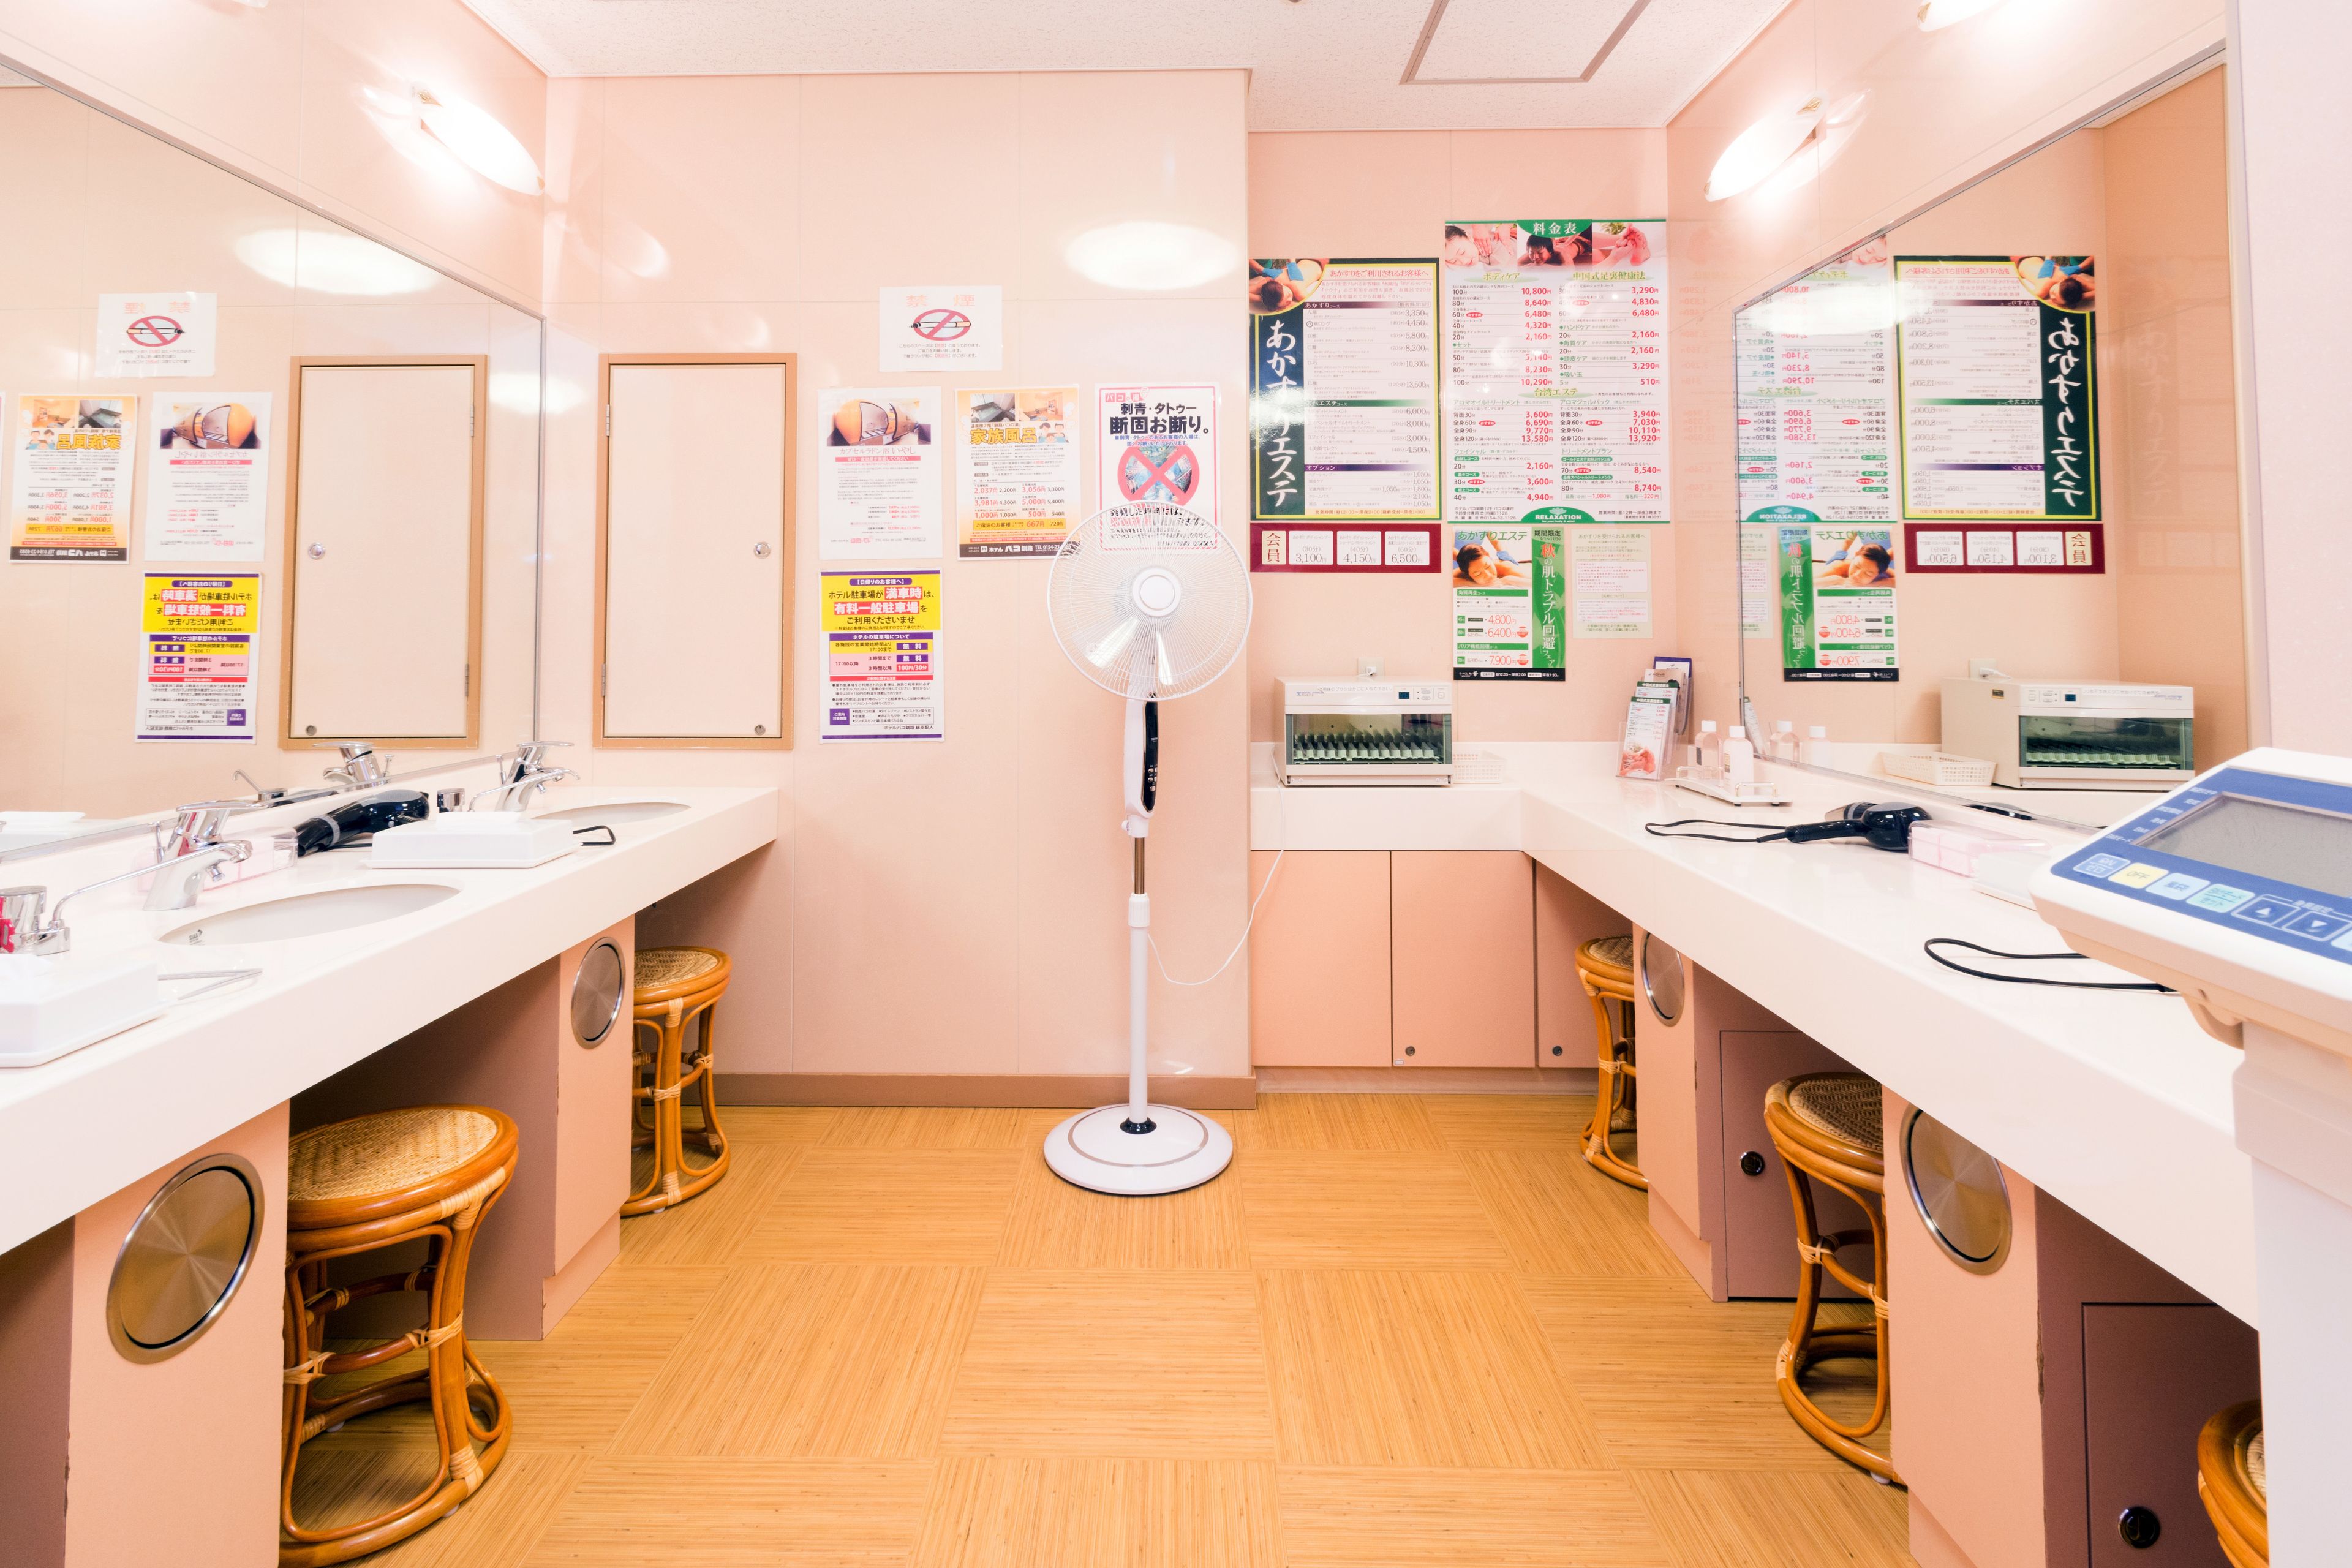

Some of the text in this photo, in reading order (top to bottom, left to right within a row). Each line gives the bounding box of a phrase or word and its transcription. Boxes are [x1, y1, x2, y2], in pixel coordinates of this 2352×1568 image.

[1532, 222, 1577, 235] 料金表
[1573, 271, 1646, 280] 中国式足裏健康法
[1121, 403, 1197, 415] 刺青・タトゥー
[1110, 416, 1209, 434] 断固お断り。
[970, 428, 1037, 445] 家族風呂
[1457, 530, 1528, 541] あかすりエステ
[1266, 533, 1281, 562] 会員
[1296, 554, 1327, 564] 3,100円
[1343, 554, 1376, 564] 4,150円
[1391, 554, 1423, 564] 6,500円
[829, 590, 883, 599] ホテル駐車場が
[886, 588, 922, 599] 満車時
[835, 603, 918, 614] 有料一般駐車場
[1541, 543, 1556, 667] 秋の肌トラブル回避フェア
[1488, 615, 1517, 625] 4,800円
[1488, 628, 1517, 638] 6,400円
[1490, 655, 1517, 665] 7,900円
[2126, 871, 2150, 880] OFF
